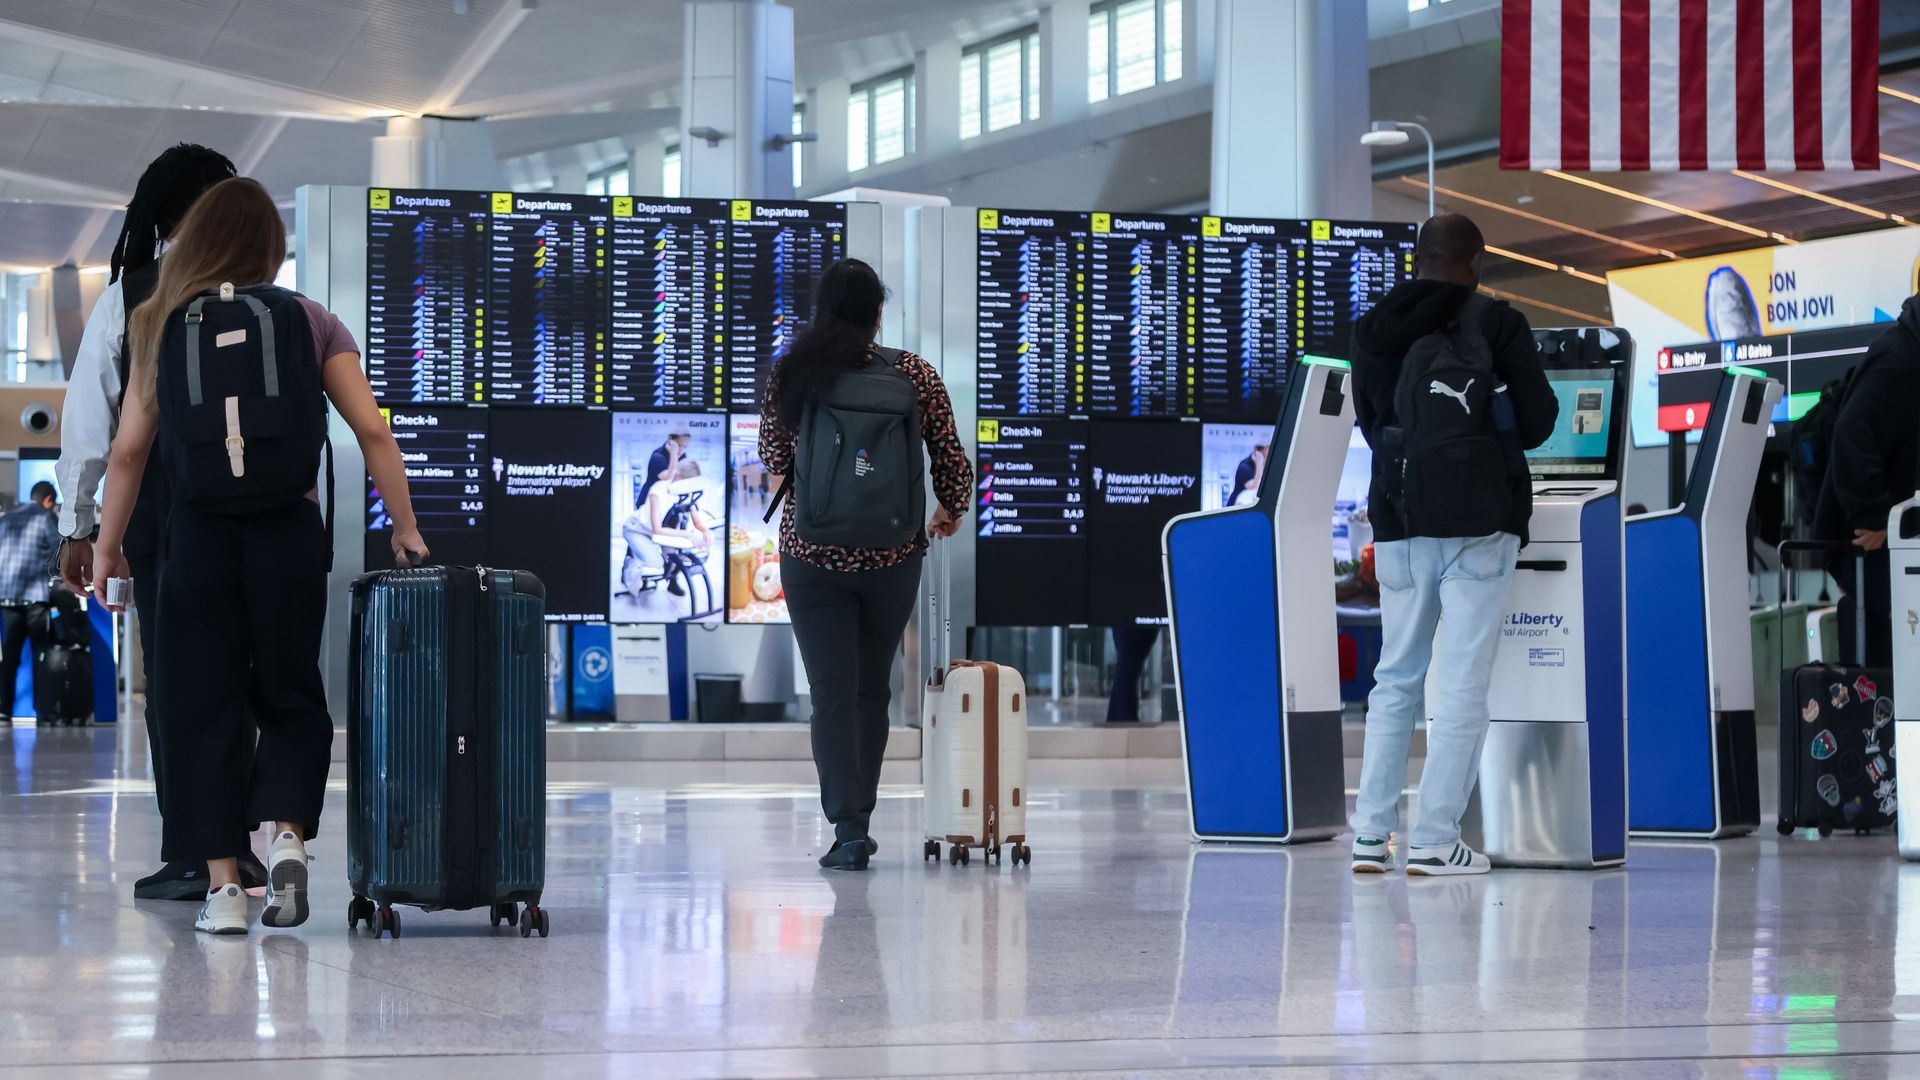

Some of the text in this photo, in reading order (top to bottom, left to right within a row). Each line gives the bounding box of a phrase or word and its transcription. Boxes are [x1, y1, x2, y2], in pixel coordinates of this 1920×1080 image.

[396, 196, 451, 207] Departures
[517, 199, 572, 211] Departures
[638, 203, 691, 214] Departures
[756, 206, 809, 218] Departures
[1002, 215, 1054, 227] Departures
[1114, 219, 1165, 230] Departures
[1225, 223, 1275, 234] Departures
[1334, 226, 1383, 238] Departures
[1768, 270, 1796, 294] JON
[1767, 294, 1835, 323] BON JOVI
[1736, 343, 1772, 360] All Gates
[1672, 351, 1706, 368] No Entry
[392, 415, 438, 426] Check-in
[1001, 426, 1042, 437] Check-in
[401, 452, 428, 461] Canada
[469, 453, 474, 462] 1
[507, 464, 604, 479] Newark Liberty
[994, 463, 1033, 471] Air Canada
[1072, 463, 1077, 471] 1
[405, 468, 454, 477] ican Airlines
[465, 469, 479, 478] 1,2
[507, 477, 592, 488] International Airport
[994, 477, 1057, 486] American Airlines
[1068, 478, 1080, 487] 1,2
[1106, 473, 1195, 488] Newark Liberty
[464, 485, 479, 494] 2,3
[506, 486, 554, 495] Terminal A
[1107, 485, 1184, 496] International Airport
[993, 493, 1014, 501] Delta
[1066, 493, 1081, 502] 2,3
[1106, 495, 1142, 503] Terminal
[461, 502, 483, 511] 3,4,5
[993, 508, 1018, 518] United
[1063, 509, 1084, 518] 3,4,5
[468, 517, 476, 526] 6
[994, 524, 1022, 533] JetBlue
[1070, 525, 1077, 533] 6
[1512, 612, 1564, 628] Liberty
[1517, 628, 1549, 638] Airport
